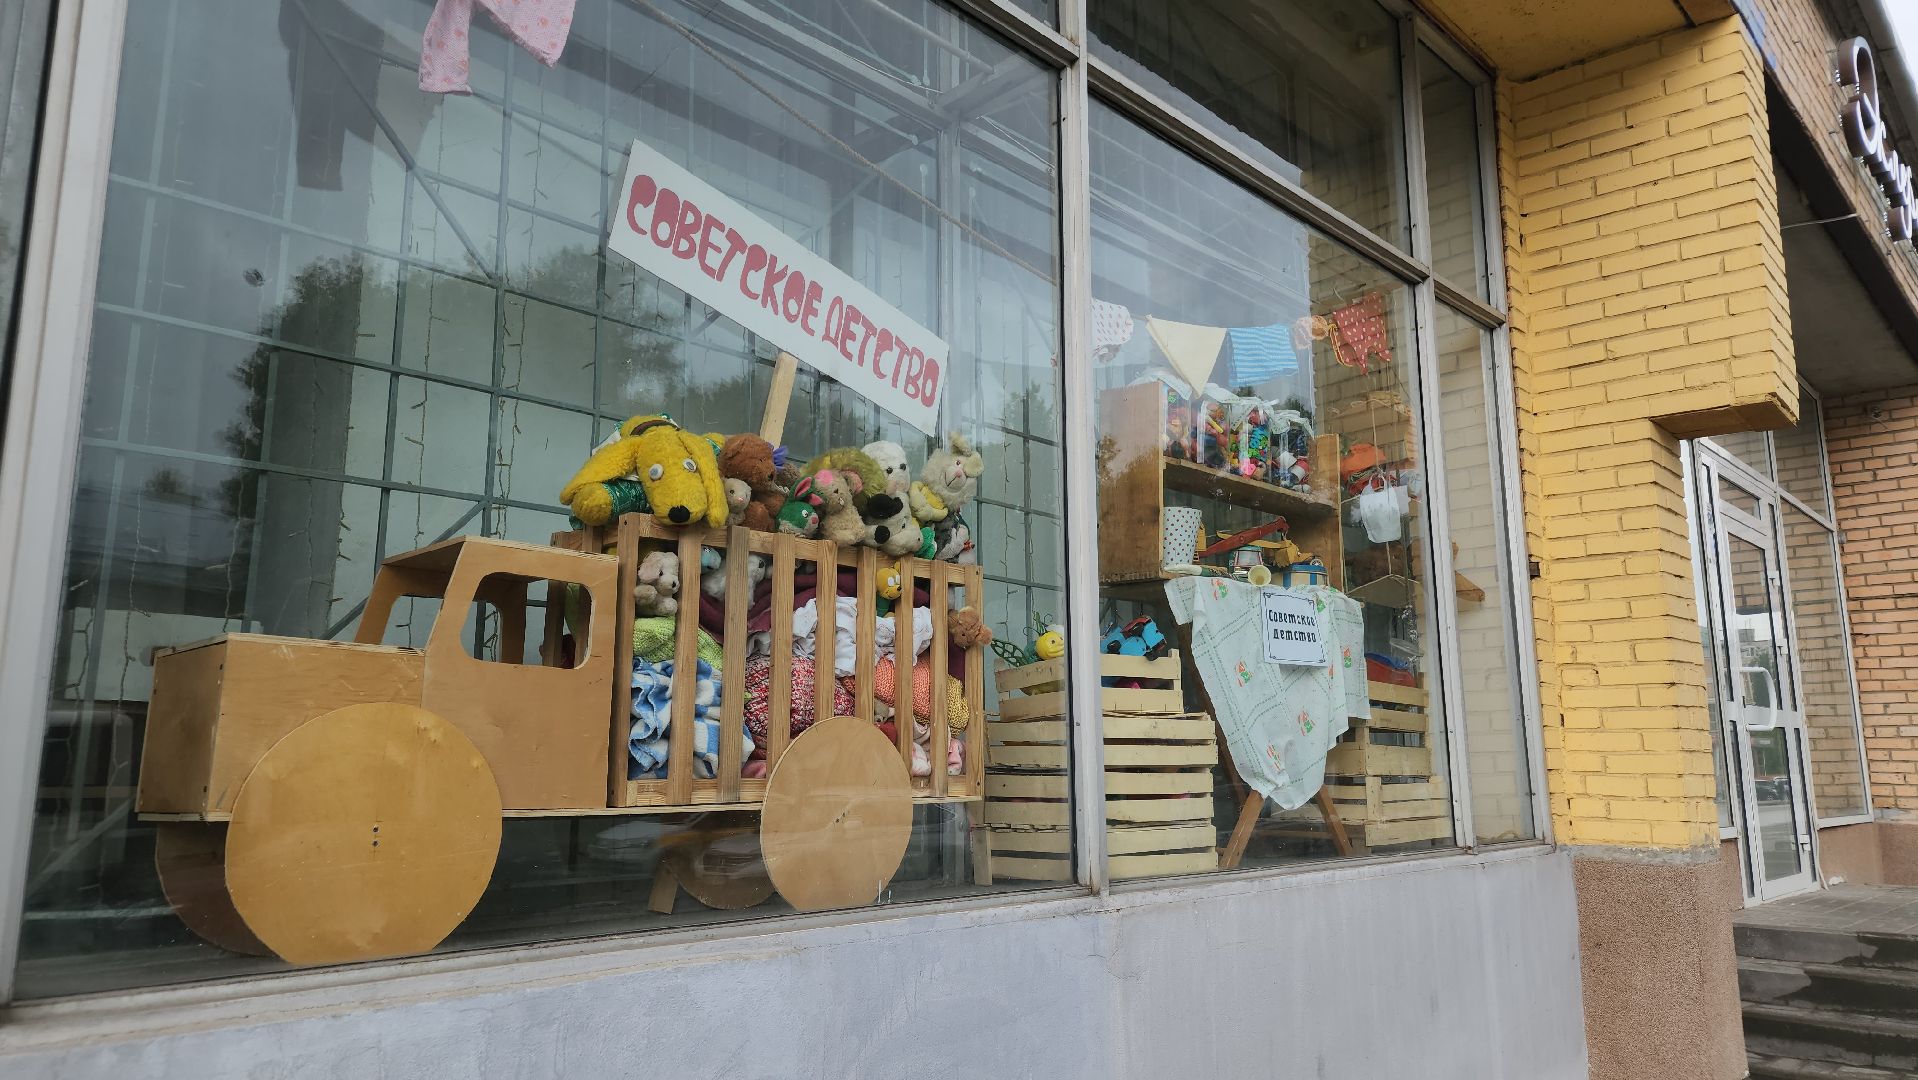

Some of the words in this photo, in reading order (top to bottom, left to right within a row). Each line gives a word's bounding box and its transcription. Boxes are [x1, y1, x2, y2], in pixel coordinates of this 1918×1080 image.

[627, 174, 823, 336] СОВЕТСКОЕ
[822, 295, 940, 407] ДЕТСТВО
[1268, 609, 1316, 627] Советское
